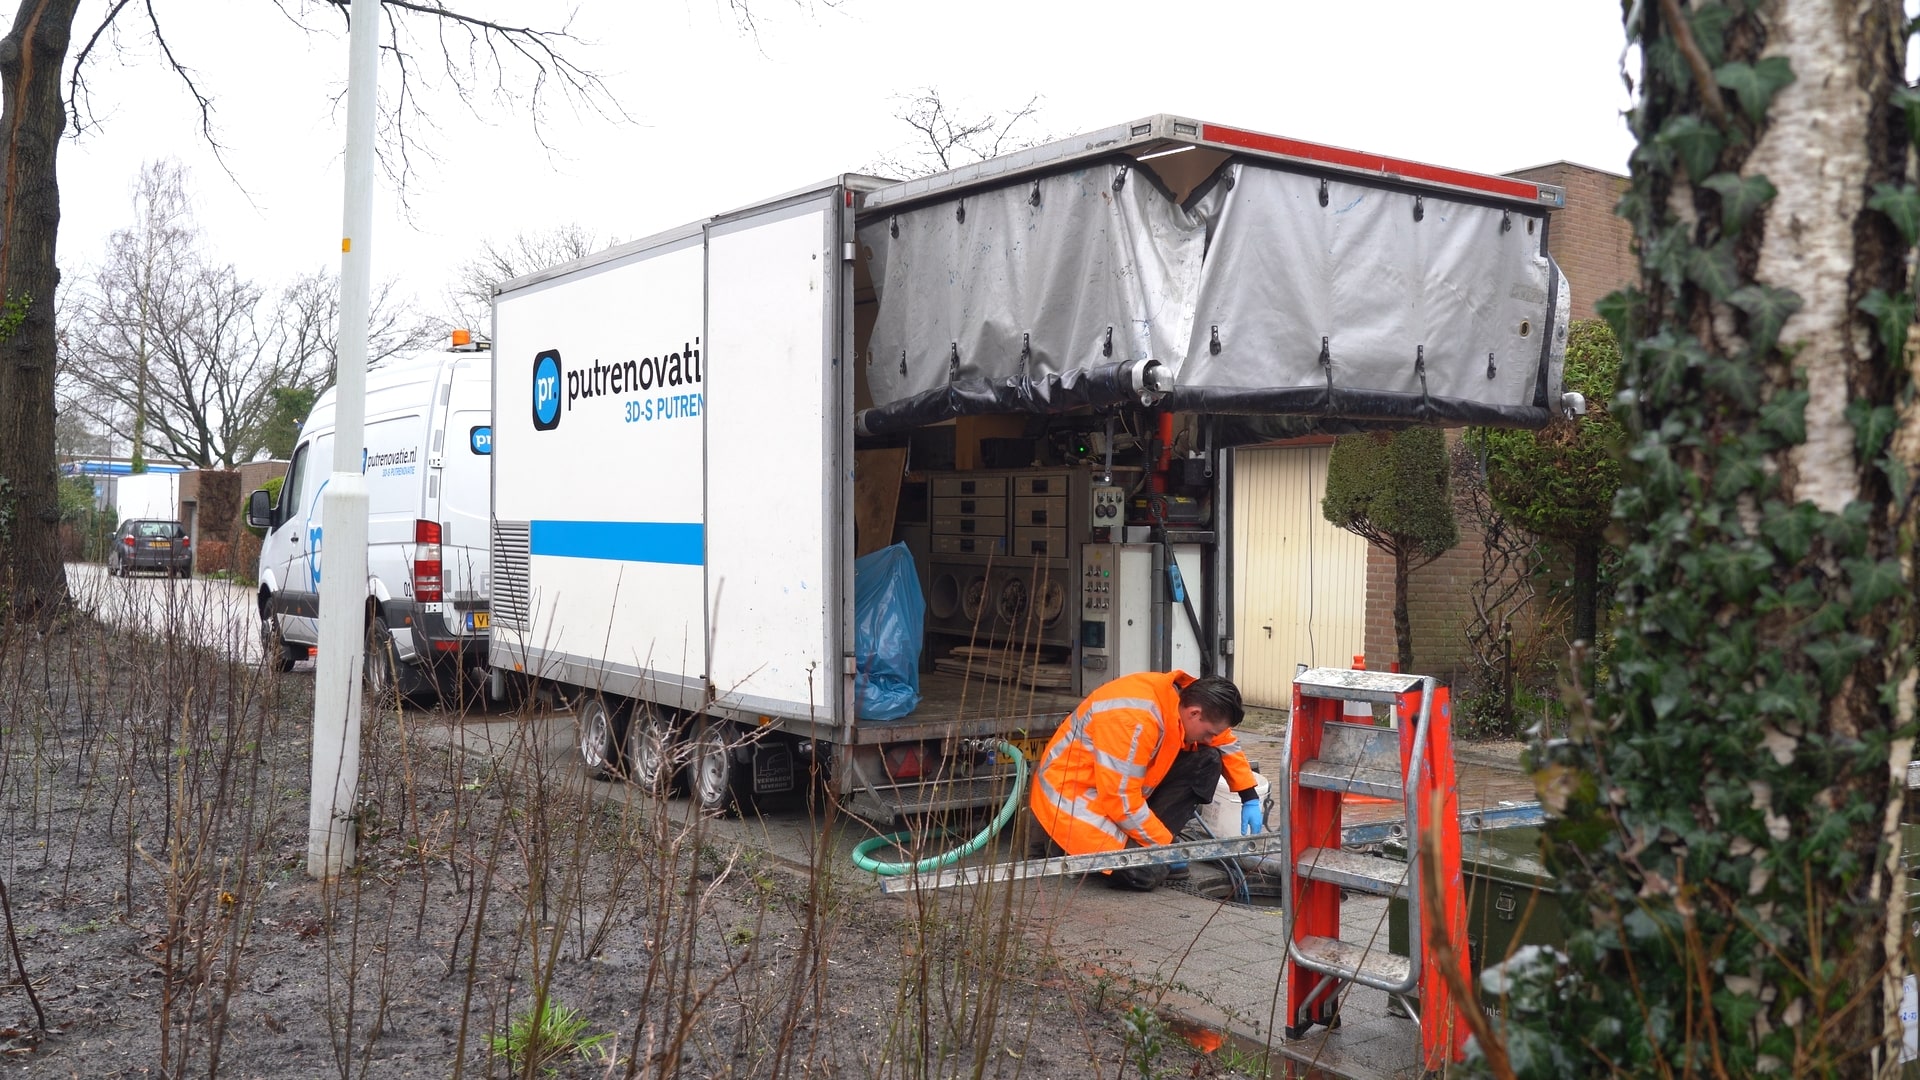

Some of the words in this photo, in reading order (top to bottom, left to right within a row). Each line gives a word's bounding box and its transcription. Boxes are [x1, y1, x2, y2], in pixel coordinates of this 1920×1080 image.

[567, 337, 702, 411] putrenovati
[625, 399, 653, 423] 3D-S
[367, 446, 418, 472] putrenovatie.nl
